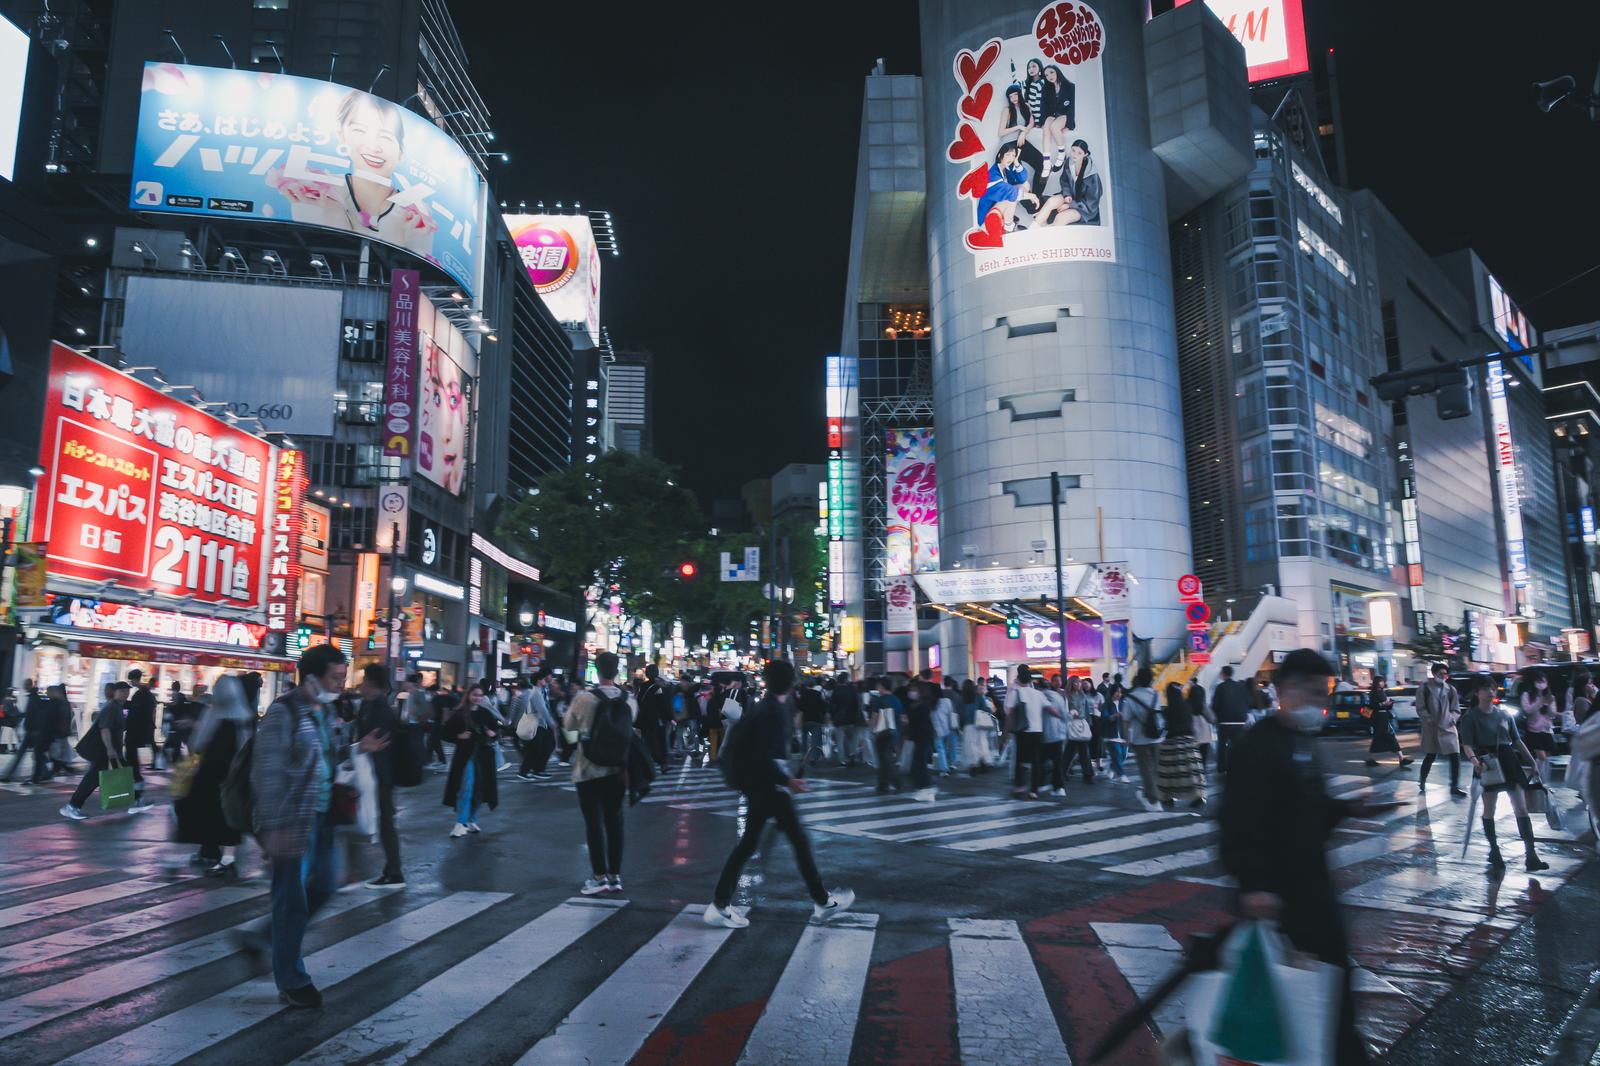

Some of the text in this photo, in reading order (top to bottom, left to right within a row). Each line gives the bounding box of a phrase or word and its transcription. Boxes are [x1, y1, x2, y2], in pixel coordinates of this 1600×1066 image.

[1036, 2, 1094, 39] 45th
[978, 259, 1000, 273] 45th
[1041, 248, 1112, 259] SHIBUYA109
[391, 293, 413, 401] 品川美容外科
[57, 474, 147, 525] エスパス
